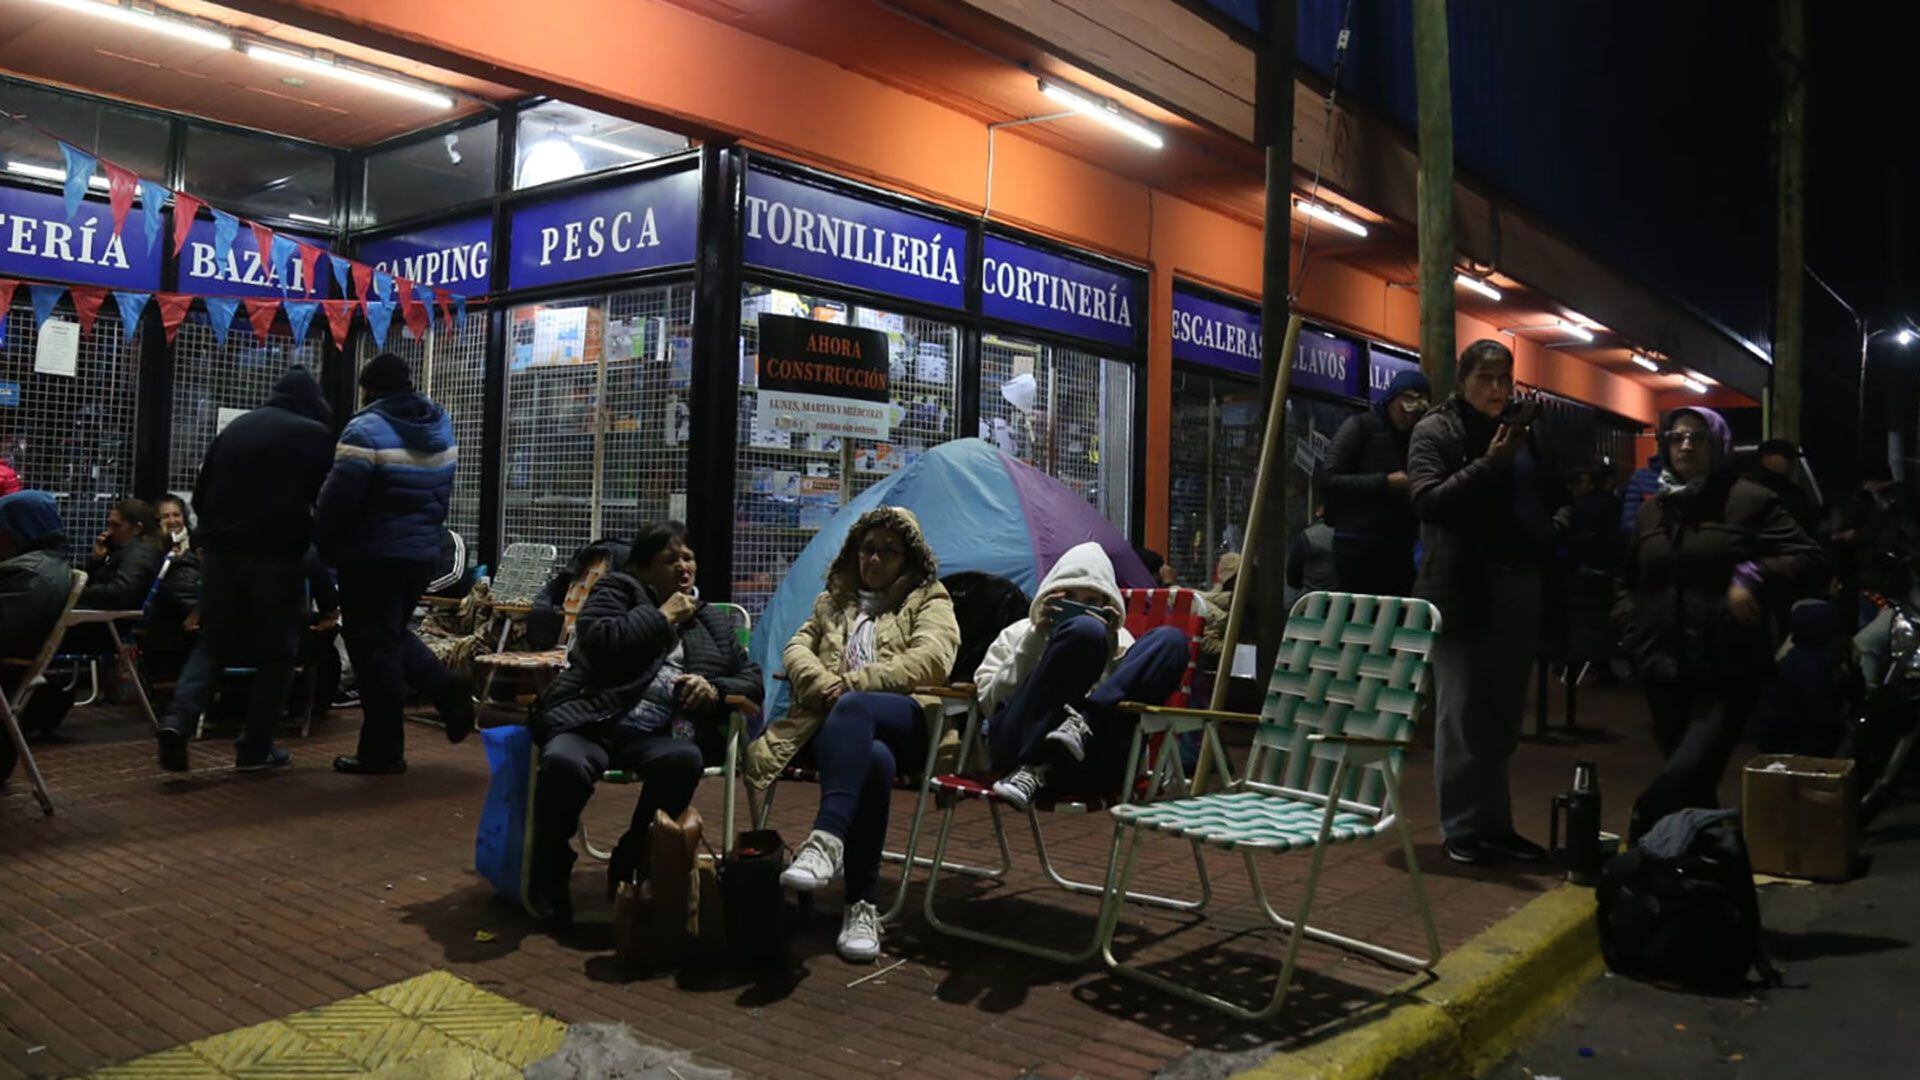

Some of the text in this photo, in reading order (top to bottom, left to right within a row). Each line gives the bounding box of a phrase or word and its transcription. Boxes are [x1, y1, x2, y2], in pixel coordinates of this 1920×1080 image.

[0, 214, 130, 269] ERÍA
[540, 207, 660, 266] PESCA
[746, 195, 960, 285] TORNILLERÍA
[983, 257, 1132, 327] CORTINERÍA
[807, 335, 861, 358] AHORA
[1291, 345, 1347, 381] LAVOS
[767, 358, 886, 390] CONSTRUCCIÓN
[802, 402, 835, 413] MARTES
